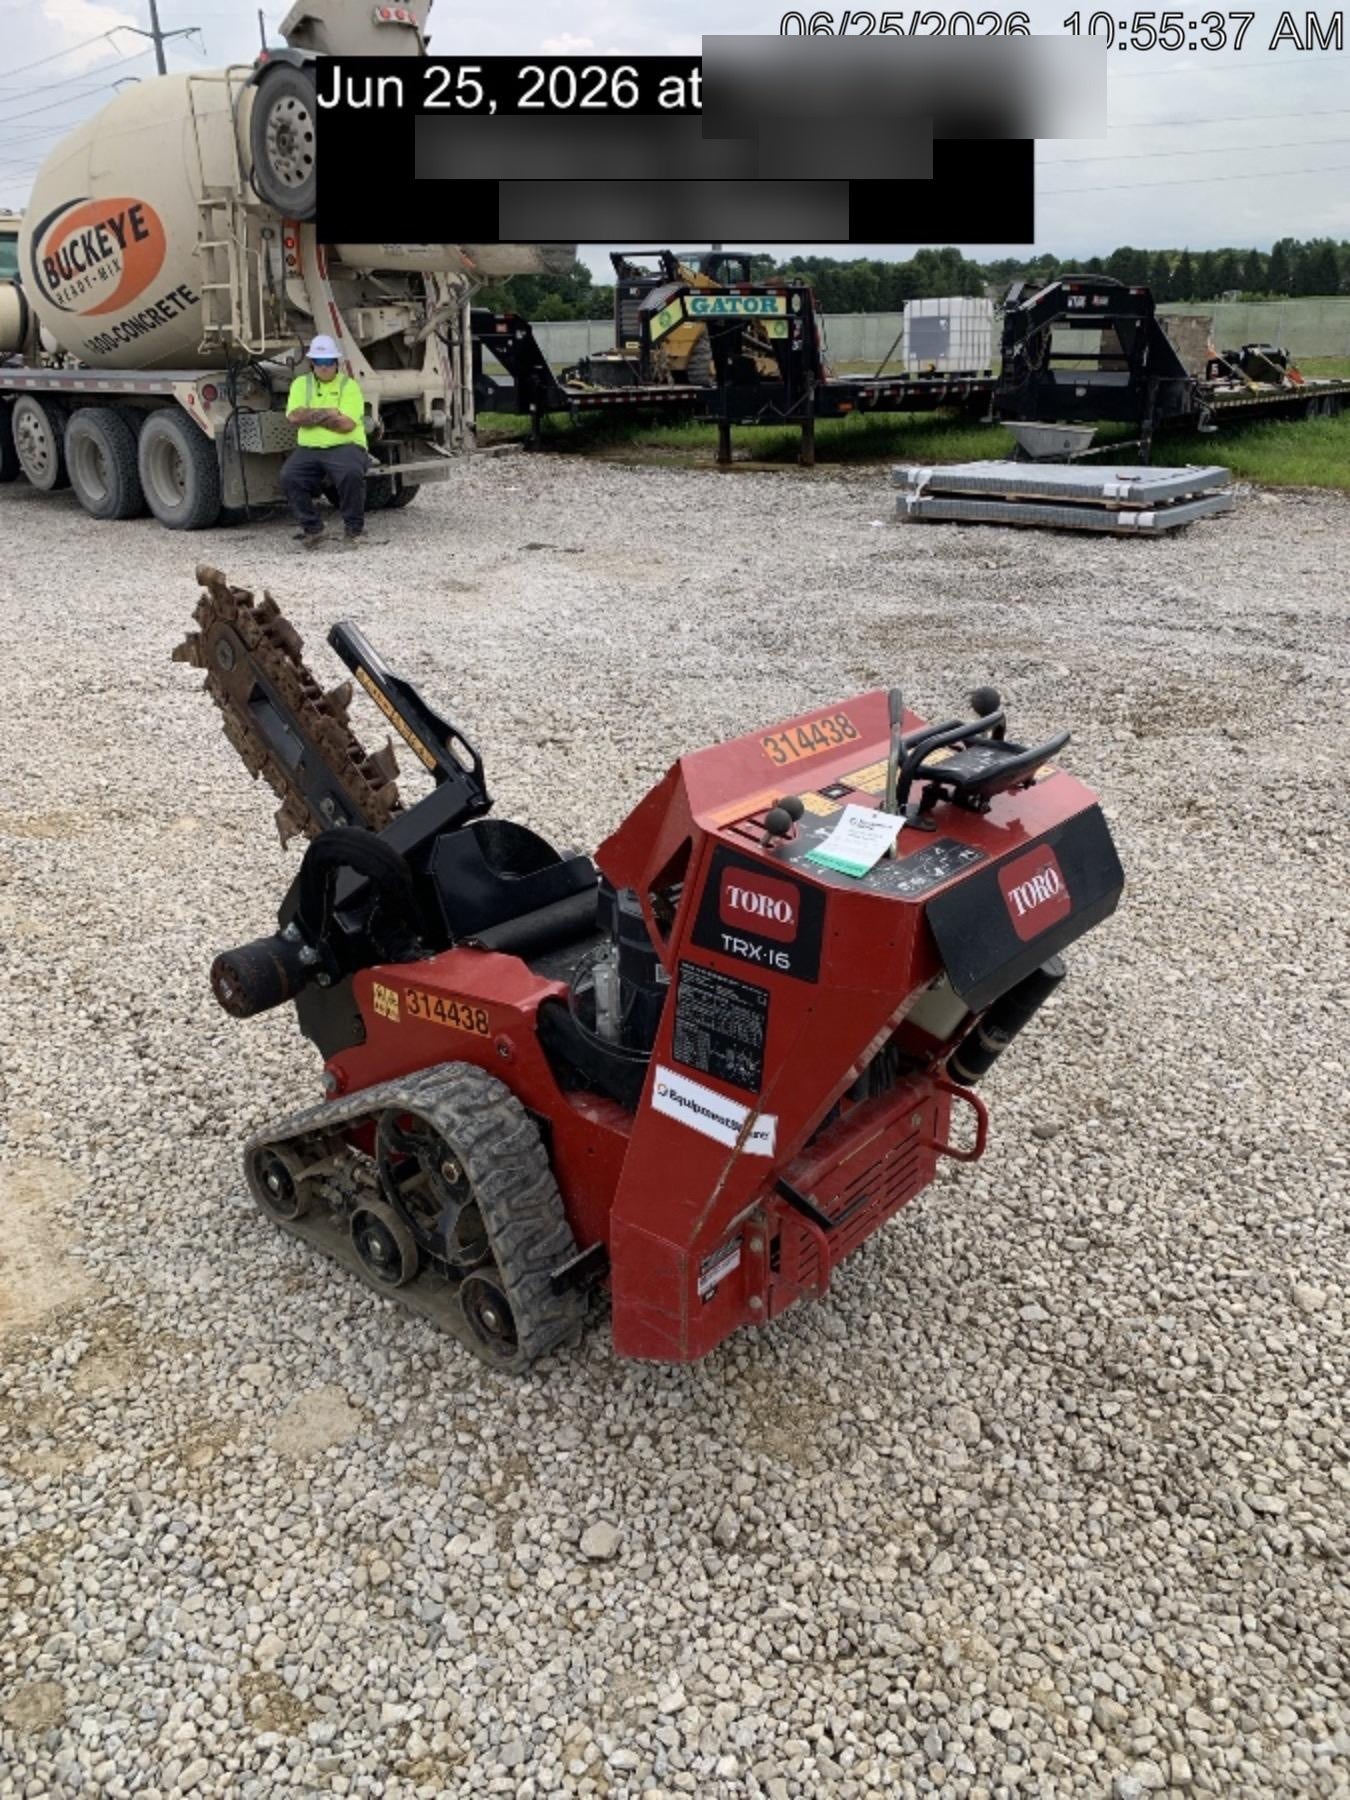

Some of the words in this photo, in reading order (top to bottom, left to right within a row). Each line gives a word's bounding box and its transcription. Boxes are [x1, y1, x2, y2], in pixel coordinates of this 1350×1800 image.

[43, 204, 149, 290] BUCKEYE
[691, 297, 779, 313] GATOR
[763, 713, 857, 764] 314438
[727, 886, 793, 924] TORO
[1008, 868, 1059, 917] TORO
[407, 989, 489, 1035] 314438
[669, 1089, 769, 1141] EquipmentSre
